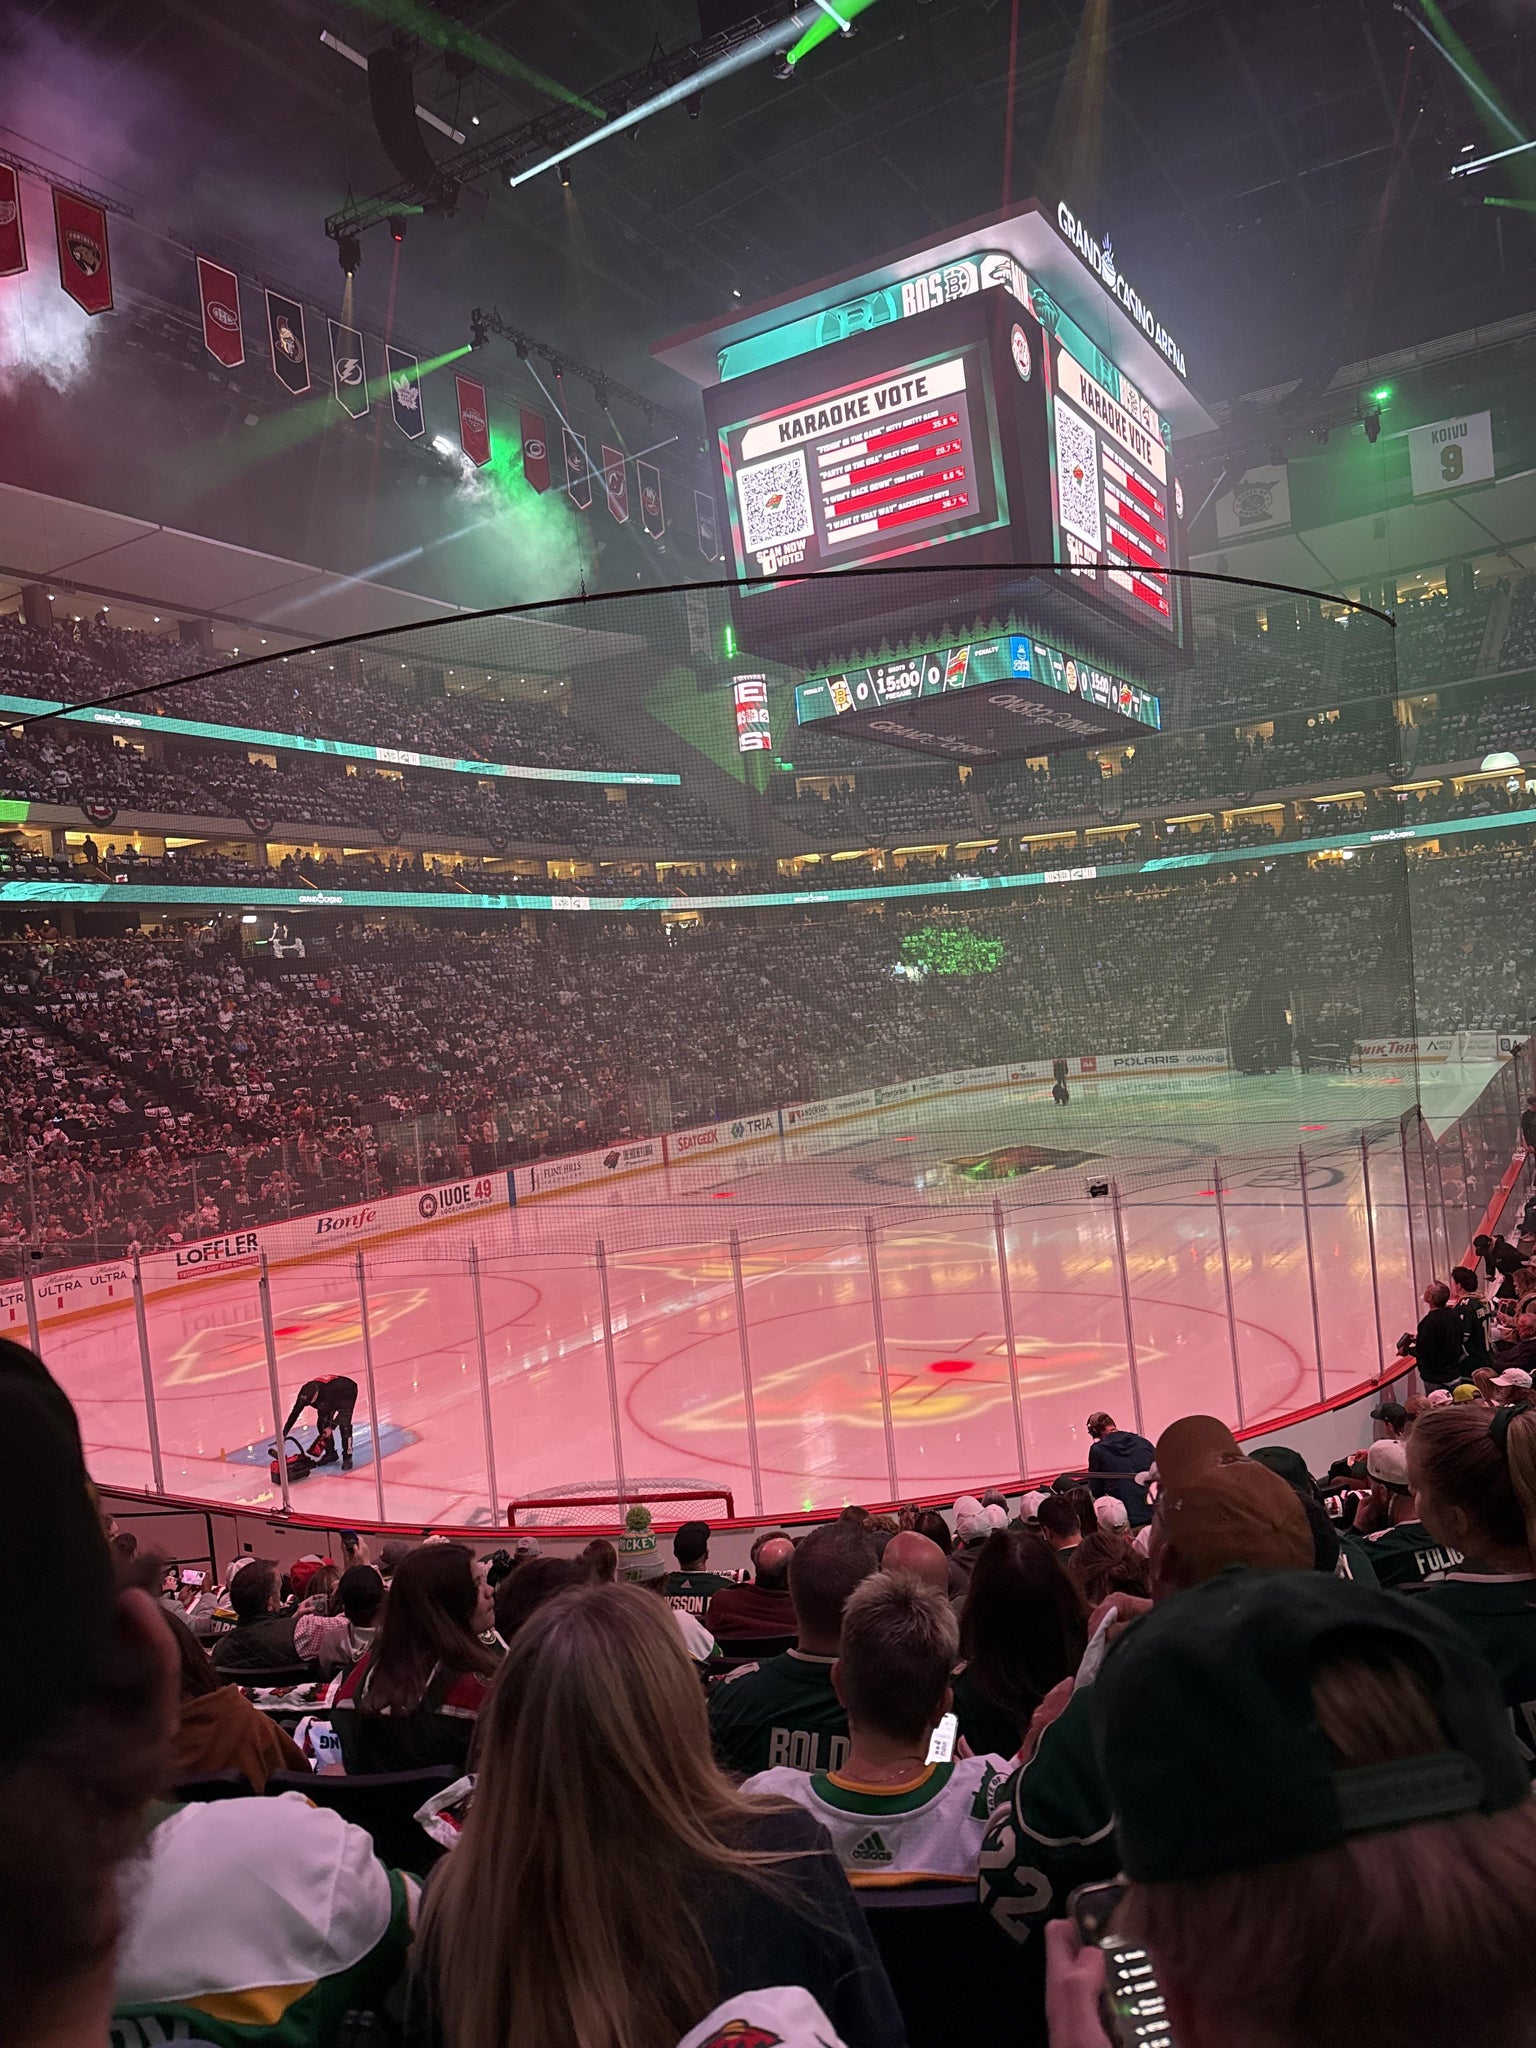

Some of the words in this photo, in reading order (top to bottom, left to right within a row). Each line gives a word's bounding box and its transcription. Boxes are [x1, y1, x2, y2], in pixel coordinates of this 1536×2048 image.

[901, 272, 944, 318] BOS
[1057, 201, 1102, 275] GRAND
[1116, 274, 1154, 339] CASINO
[1154, 322, 1187, 378] ARENA
[778, 395, 869, 443] KARAOKE
[874, 376, 929, 411] VOTE
[1079, 373, 1128, 443] KARAOKE
[1128, 421, 1152, 466] VOTE
[1431, 423, 1468, 445] KOIVU
[1440, 444, 1464, 482] 9
[756, 544, 783, 563] SCAN
[784, 538, 806, 556] NOW
[974, 646, 999, 656] PENALTY
[876, 670, 920, 694] 15:00
[928, 666, 940, 684] 0
[1081, 672, 1088, 692] 0
[1091, 672, 1109, 694] 15:00
[856, 682, 868, 700] 0
[1112, 686, 1118, 704] 0
[1114, 1056, 1179, 1066] POLARIS
[746, 1117, 774, 1134] TRIA
[678, 1129, 719, 1152] SEATGEEK
[440, 1184, 471, 1208] IUOE
[474, 1178, 492, 1198] 49
[316, 1208, 377, 1235] Bonfe
[176, 1232, 259, 1266] LOFFLER
[38, 1280, 83, 1298] ULTRA
[90, 1270, 127, 1286] ULTRA
[852, 1850, 892, 1861] adidas
